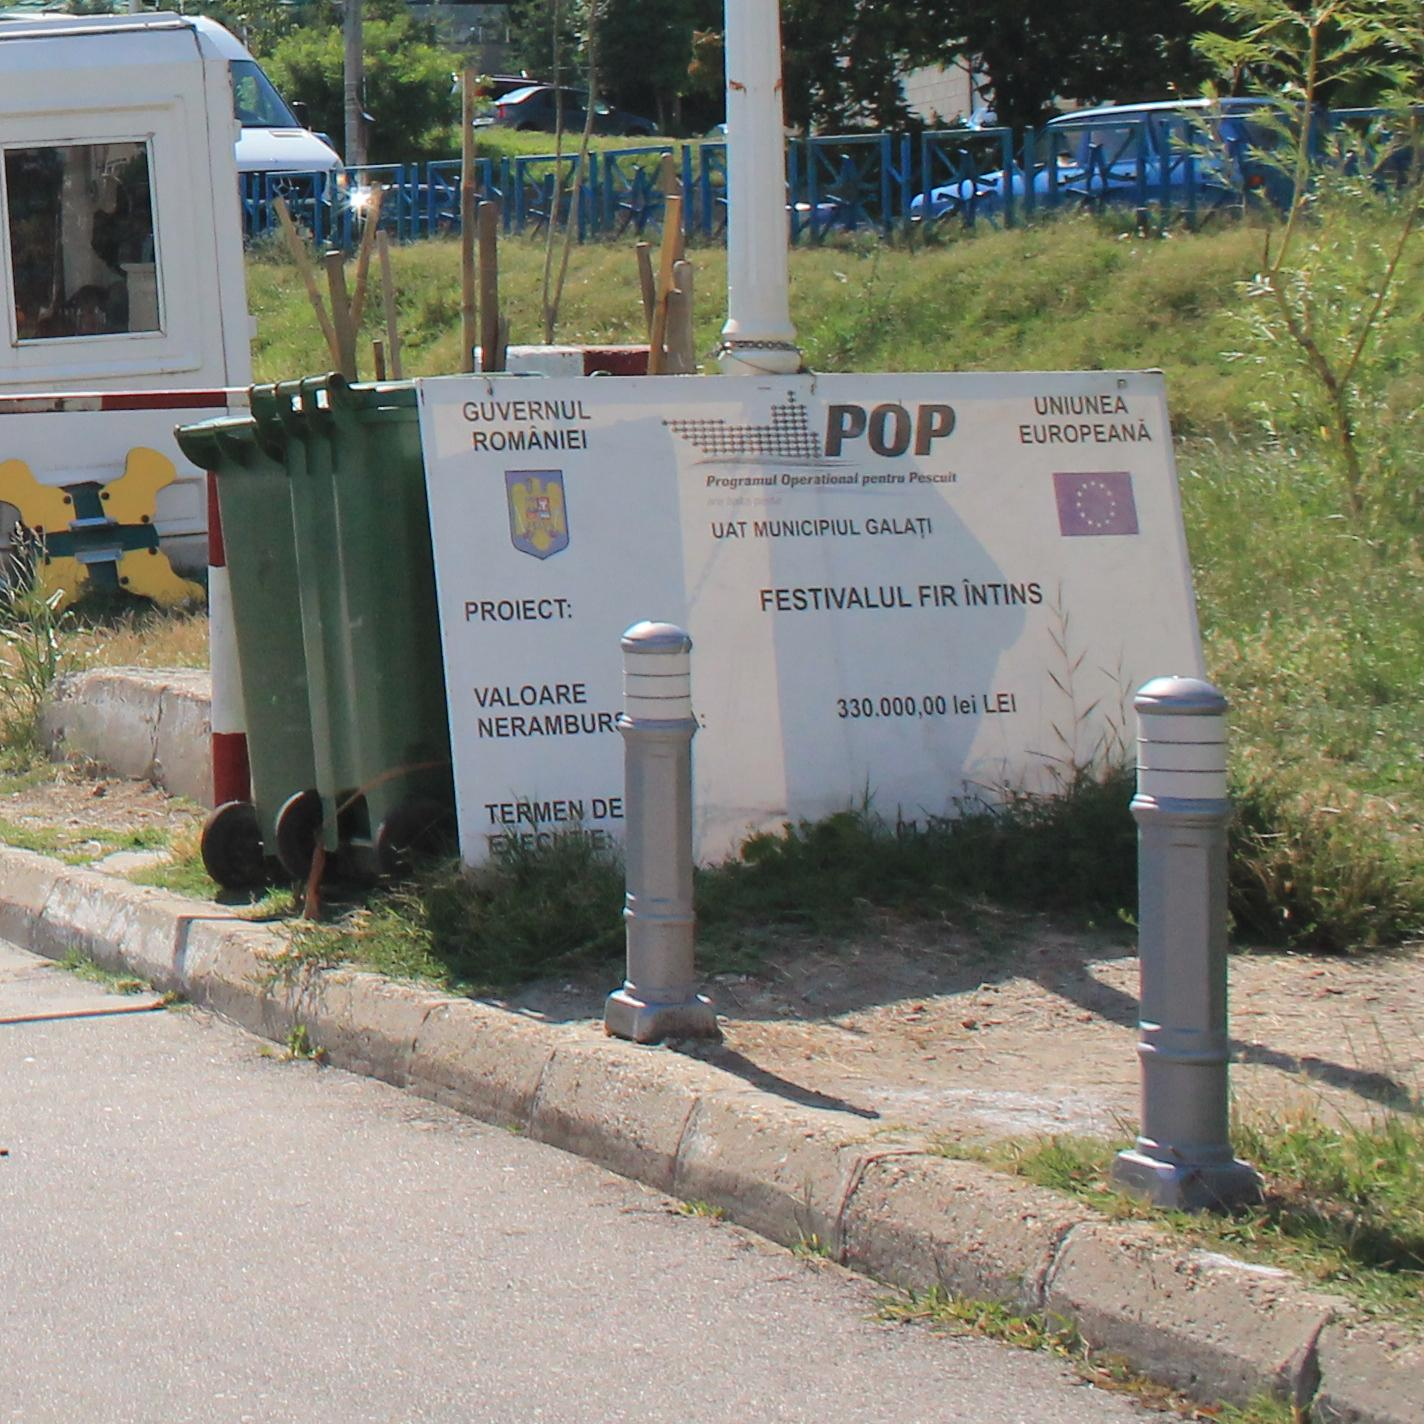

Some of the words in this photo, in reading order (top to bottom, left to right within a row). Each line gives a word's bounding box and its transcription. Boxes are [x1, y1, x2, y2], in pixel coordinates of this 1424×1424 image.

[463, 401, 591, 422] GUVERNUL
[1034, 396, 1129, 416] UNIUNEA
[473, 426, 587, 451] ROMÂNIEI
[825, 404, 956, 458] POP
[1020, 419, 1152, 444] EUROPEANĂ
[706, 475, 778, 490] Programul
[862, 472, 905, 487] pentru
[909, 472, 957, 484] Pescuit
[711, 522, 748, 539] UAT
[754, 519, 861, 537] MUNICIPIUL
[760, 585, 912, 611] FESTIVALUL
[918, 585, 958, 607] FIR
[963, 579, 1043, 606] ÎNTINS
[464, 599, 573, 622] PROIECT:
[474, 683, 588, 708] VALOARE
[837, 695, 947, 719] 330.000,00
[953, 694, 977, 714] lei
[983, 693, 1017, 714] LEI
[484, 800, 584, 824] TERMEN
[592, 798, 624, 819] DE
